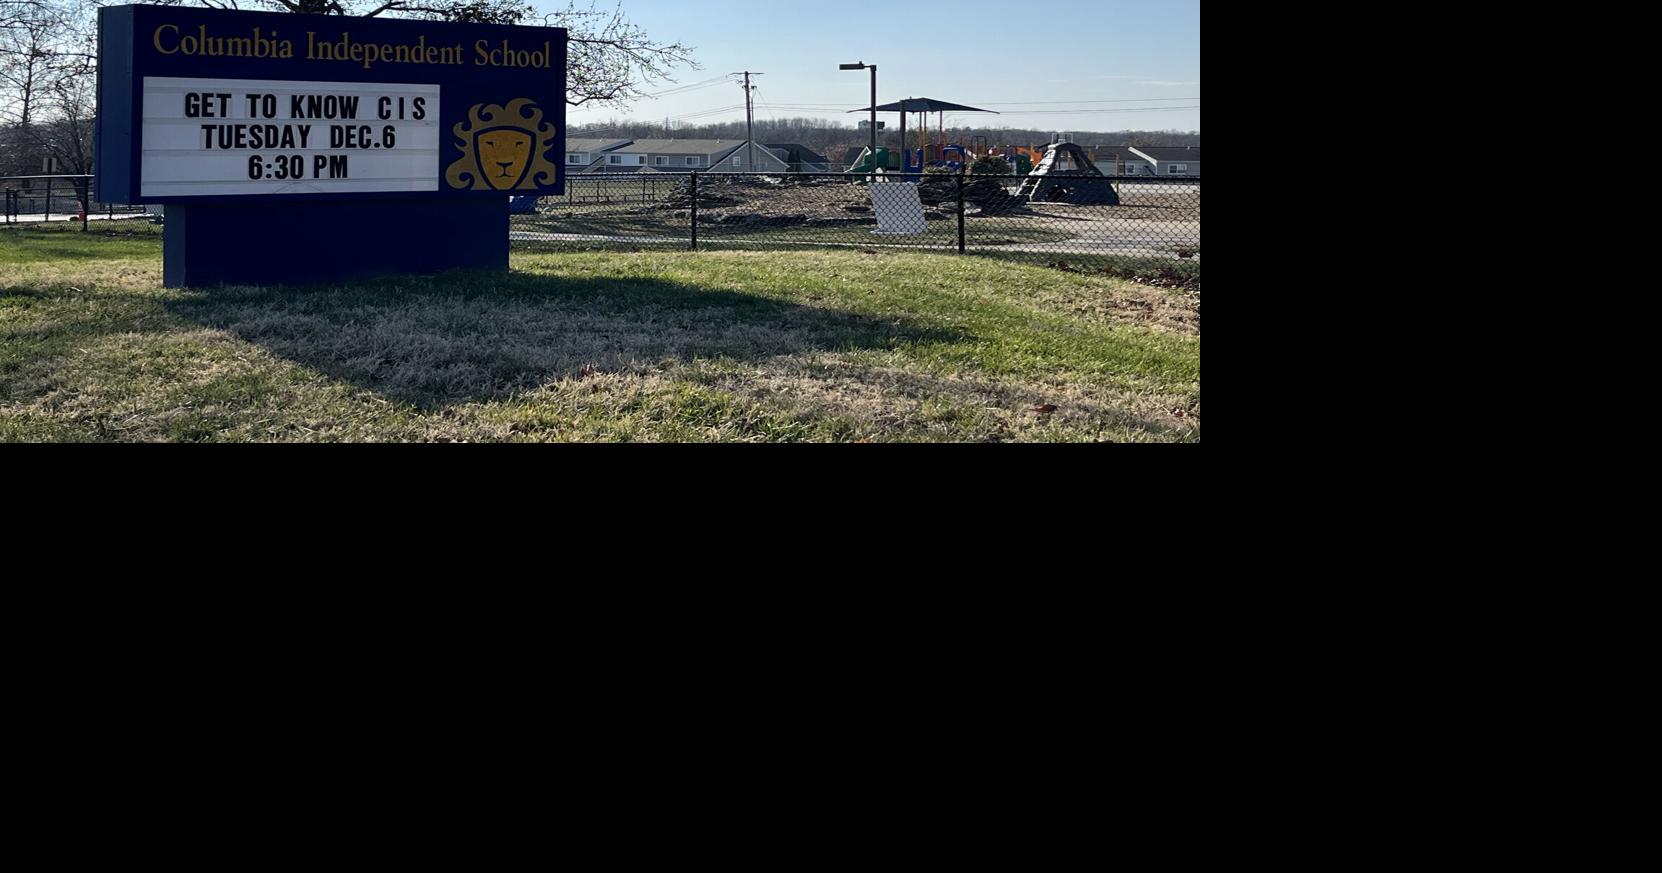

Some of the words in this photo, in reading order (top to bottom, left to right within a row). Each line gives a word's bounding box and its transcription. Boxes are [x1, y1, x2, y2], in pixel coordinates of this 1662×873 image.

[153, 24, 294, 59] Columbia
[306, 31, 464, 69] Independent
[474, 39, 551, 68] School
[184, 92, 232, 118] GET
[246, 94, 277, 118] TO
[291, 95, 360, 119] KNOW
[202, 124, 312, 149] TUESDAY
[248, 155, 304, 179] 6:30
[313, 155, 348, 178] PM
